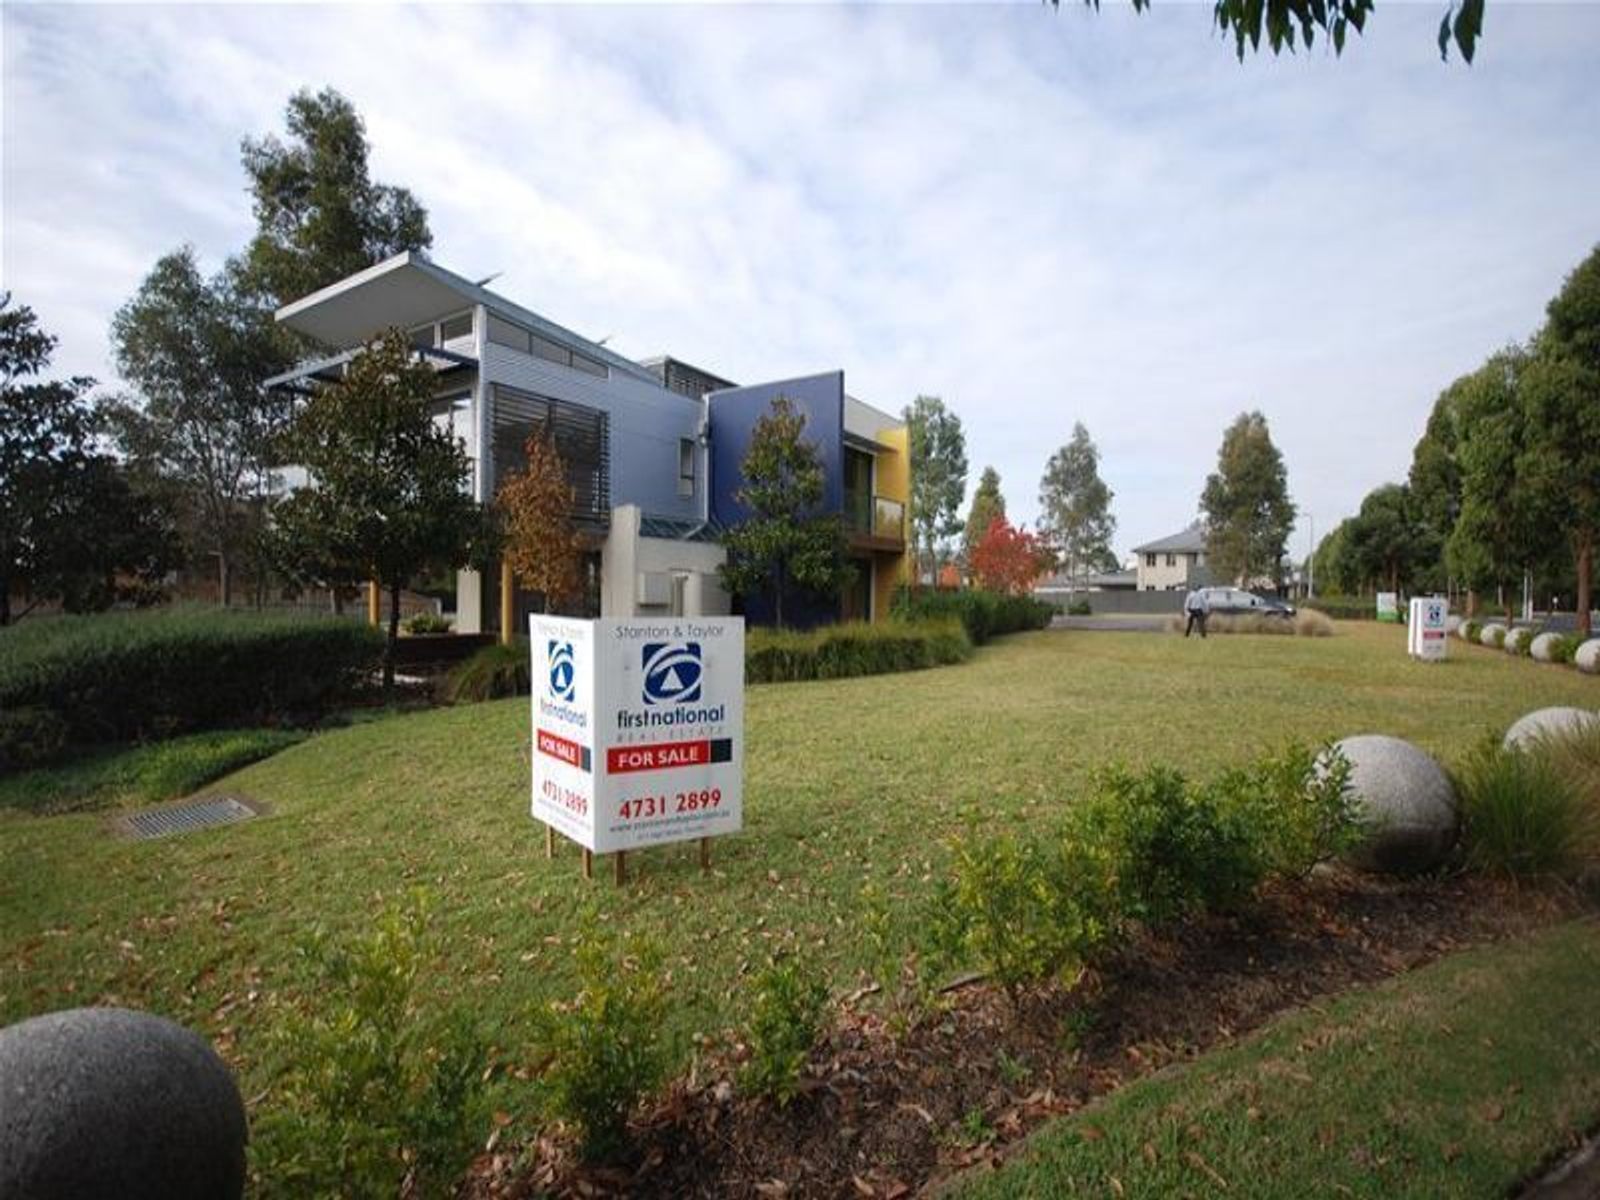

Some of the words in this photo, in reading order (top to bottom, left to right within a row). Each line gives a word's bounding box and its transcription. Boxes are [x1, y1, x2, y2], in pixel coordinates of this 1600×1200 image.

[615, 624, 670, 639] Stanton
[673, 625, 683, 638] &
[686, 623, 724, 638] Taylor
[540, 737, 556, 752] FOR
[557, 742, 576, 761] SALE
[617, 750, 654, 768] FOR
[657, 745, 700, 765] SALE
[542, 778, 562, 803] 4731
[619, 794, 666, 820] 4731
[675, 787, 722, 813] 2899
